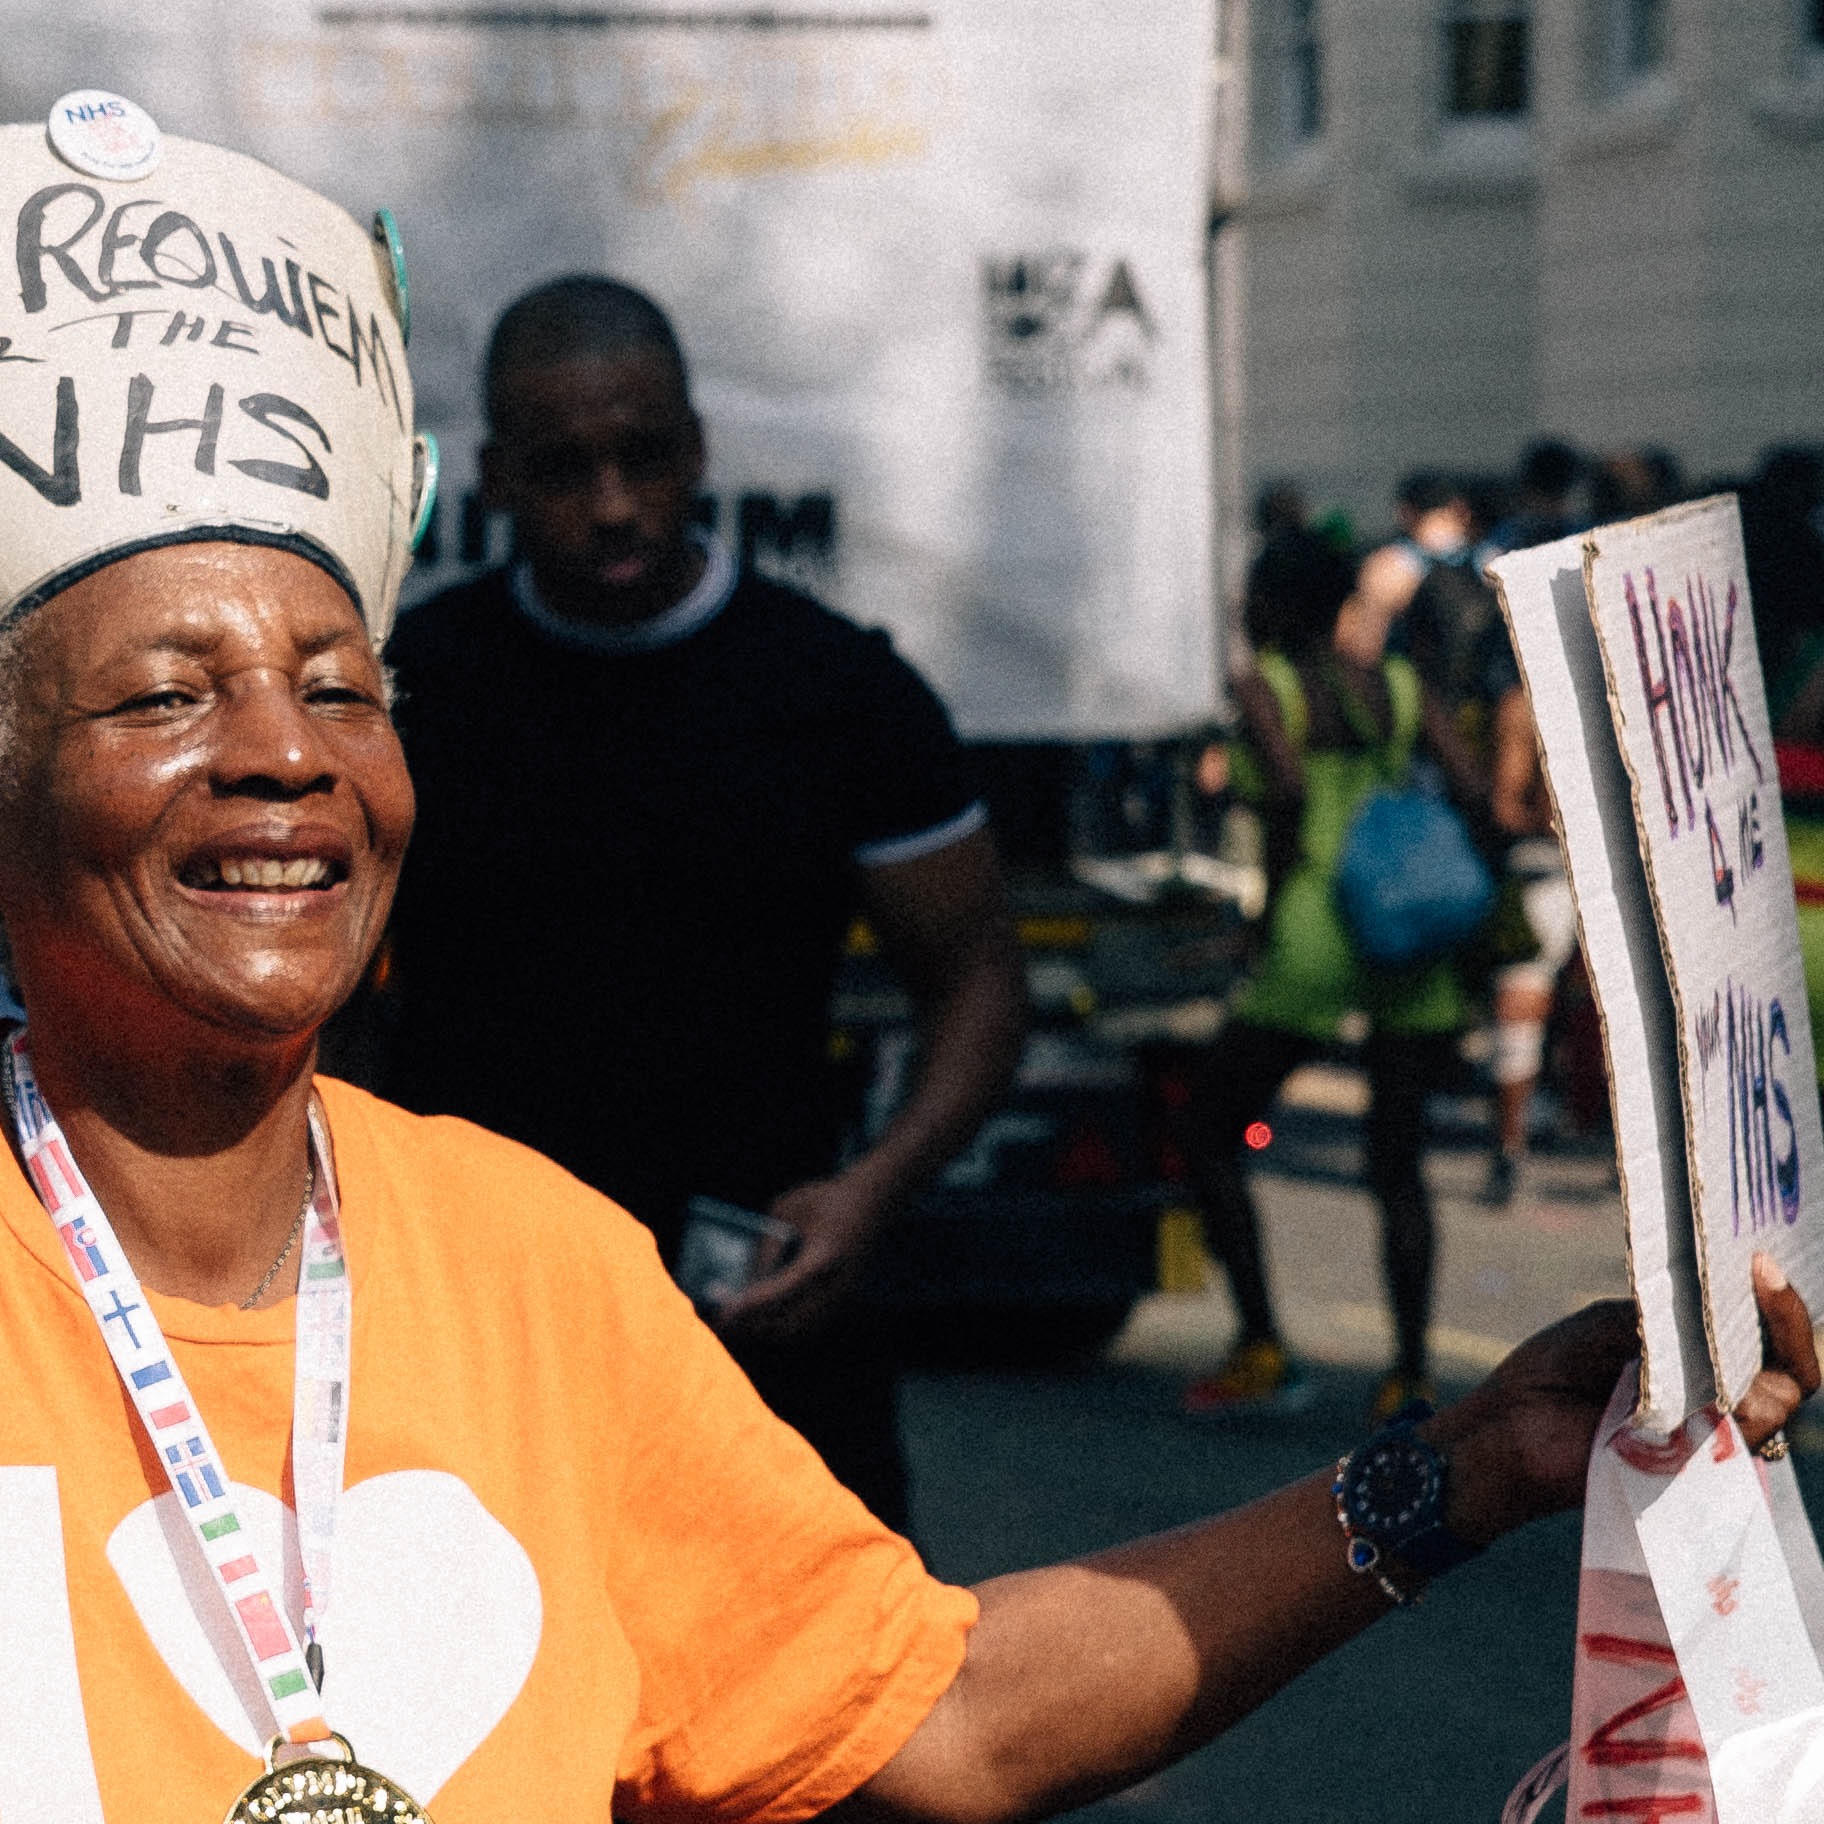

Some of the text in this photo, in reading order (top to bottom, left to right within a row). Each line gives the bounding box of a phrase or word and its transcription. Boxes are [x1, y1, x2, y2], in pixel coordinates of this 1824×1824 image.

[64, 100, 127, 126] NHS
[48, 306, 261, 356] THE
[1622, 564, 1766, 842] HONK
[1726, 974, 1801, 1240] NHS
